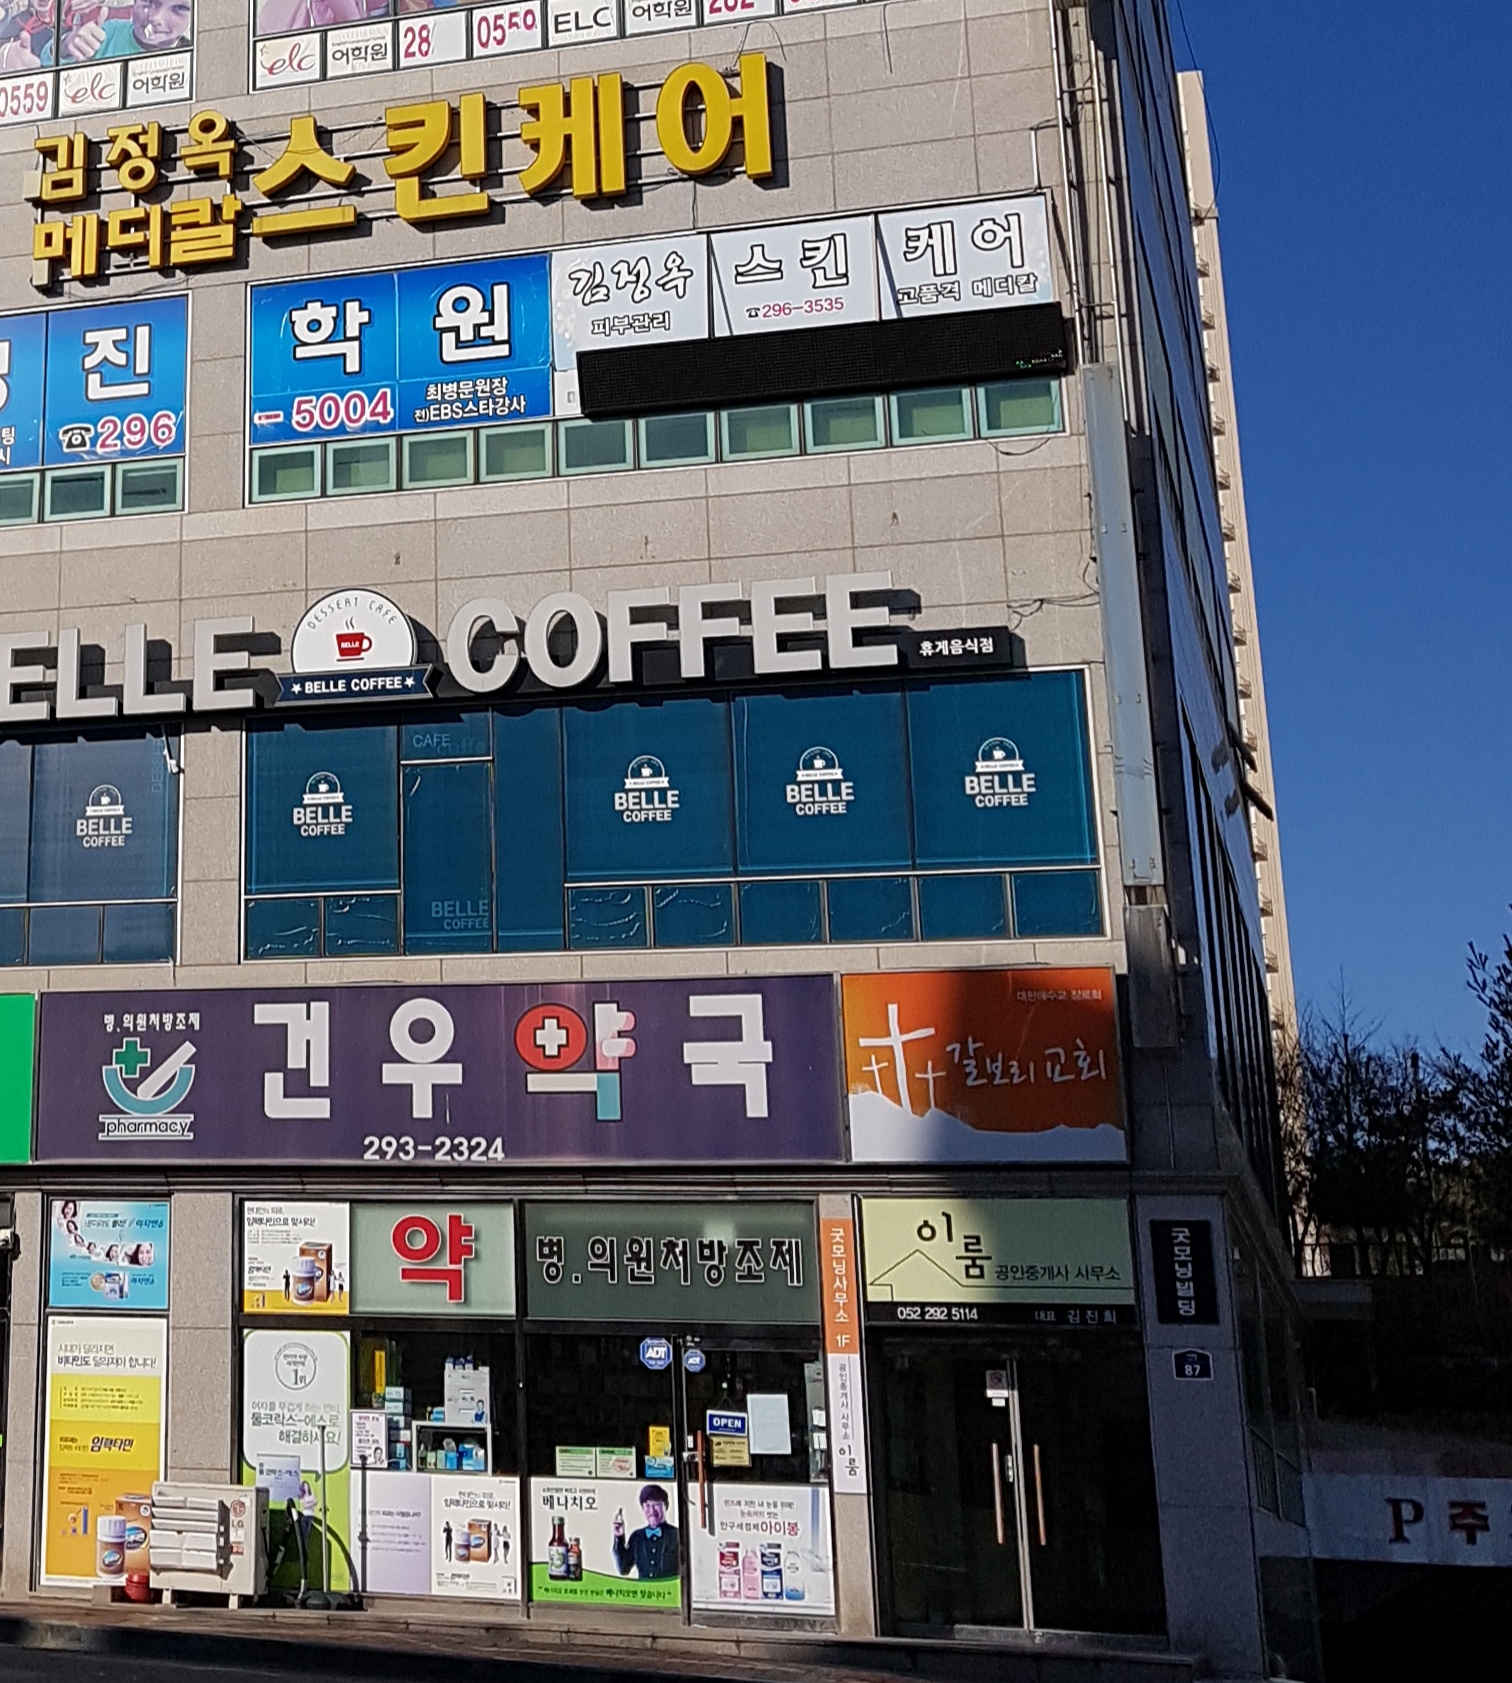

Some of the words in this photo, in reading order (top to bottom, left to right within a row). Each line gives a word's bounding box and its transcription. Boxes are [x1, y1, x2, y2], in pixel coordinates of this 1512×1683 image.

[553, 7, 612, 34] ELC
[332, 42, 388, 65] 어학원
[131, 69, 186, 93] 어학원
[34, 109, 237, 201] 김정옥
[251, 52, 774, 236] 스킨케어
[32, 194, 245, 279] 메디칼
[568, 251, 694, 307] 김정옥
[897, 280, 961, 306] 고품격
[971, 273, 1038, 298] 메디칼
[762, 296, 844, 319] 296-3535
[289, 281, 512, 376] 학원
[589, 311, 671, 337] 피부관리
[426, 376, 508, 401] 최병문원장
[97, 410, 176, 455] 296
[307, 596, 360, 630] DESSERT
[368, 599, 398, 626] CAFE
[446, 575, 900, 694] COFFEE
[919, 637, 995, 657] 휴게음식점
[304, 680, 346, 694] BELLE
[351, 676, 403, 692] COFFEE
[786, 782, 854, 803] BELLE
[964, 773, 1036, 795] BELLE
[614, 790, 679, 810] BELLE
[795, 802, 847, 815] COFFEE
[975, 793, 1028, 807] COFFEE
[292, 805, 353, 825] BELLE
[623, 809, 672, 822] COFFEE
[76, 817, 133, 836] BELLE
[300, 824, 345, 836] COFFEE
[82, 836, 126, 848] COFFEE
[945, 1037, 1035, 1087] 갈보리
[1044, 1038, 1107, 1083] 교회
[106, 1118, 189, 1136] pharmacy
[363, 1136, 505, 1163] 293-2324
[391, 1213, 476, 1303] 약
[829, 1228, 850, 1323] 굿모닝사무소
[994, 1264, 1069, 1282] 공인중개사
[898, 1307, 921, 1320] 052
[923, 1307, 949, 1320] 292
[951, 1307, 978, 1320] 5114
[836, 1334, 851, 1347] 1F
[645, 1347, 667, 1359] ADT
[1184, 1363, 1201, 1377] 87
[713, 1417, 742, 1429] OPEN
[542, 1495, 598, 1511] 베나치오
[1385, 1498, 1424, 1545] P
